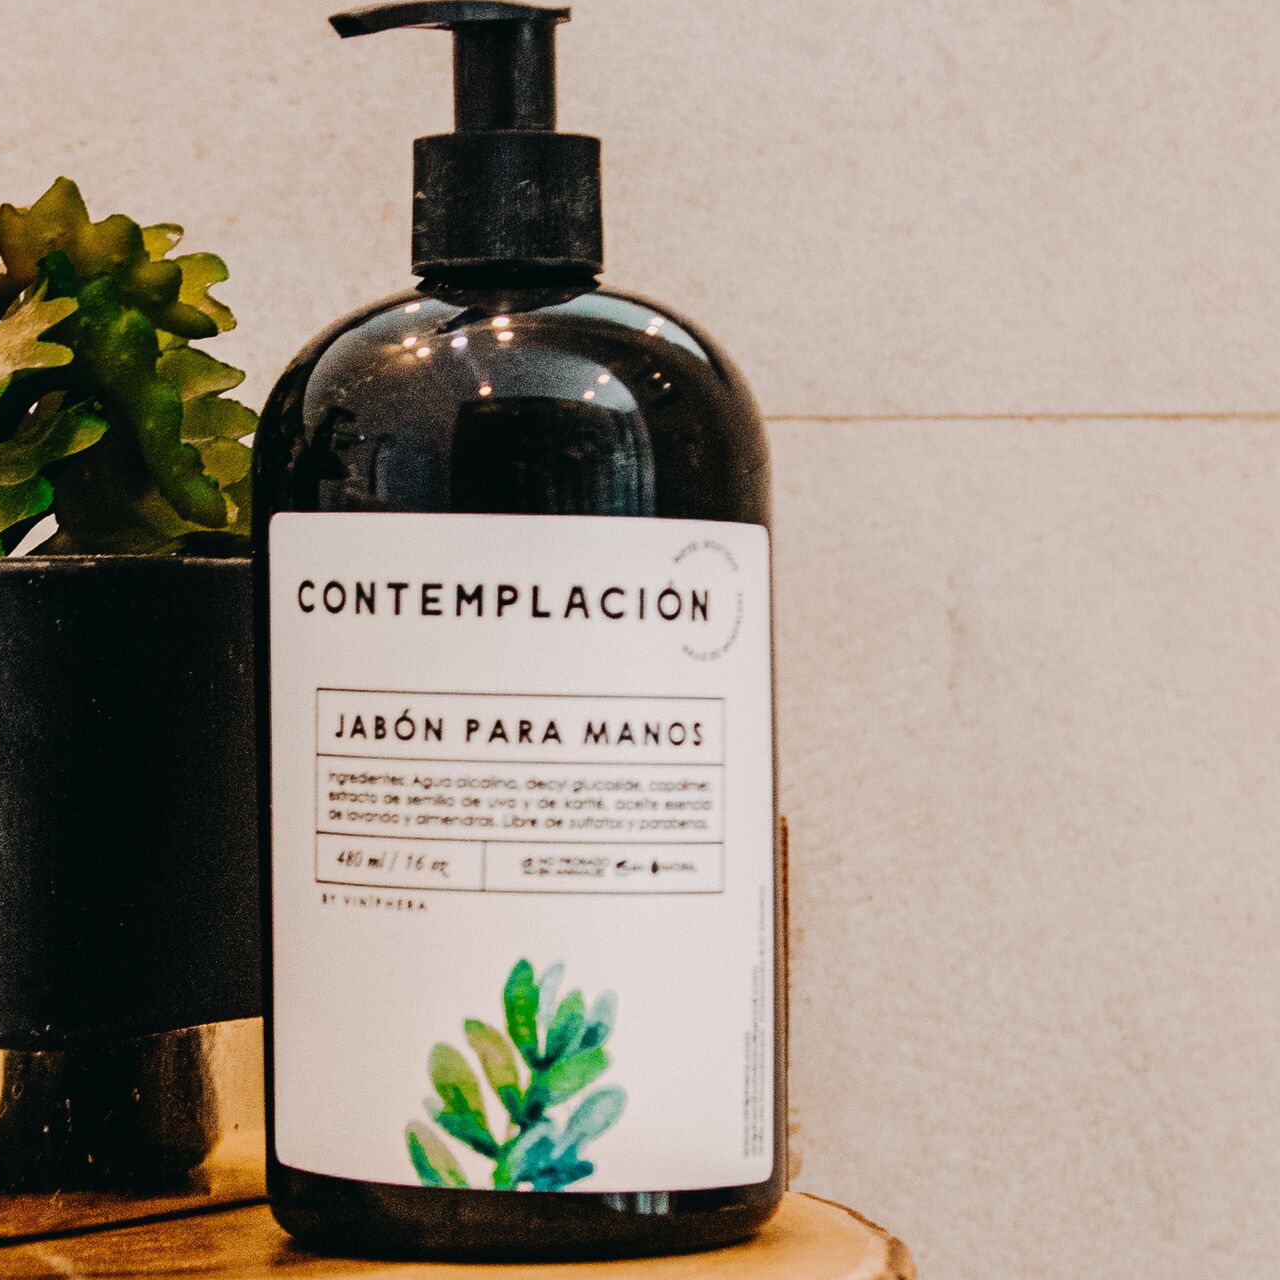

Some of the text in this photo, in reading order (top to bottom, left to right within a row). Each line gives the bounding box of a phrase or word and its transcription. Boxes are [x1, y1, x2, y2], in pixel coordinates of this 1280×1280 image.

[297, 578, 710, 622] CONTEMPLACIÓN
[334, 709, 706, 748] JABÓN PARA MANOS
[412, 775, 453, 790] Agua
[328, 790, 379, 805] extracto
[383, 792, 401, 806] de
[461, 795, 481, 808] de
[537, 796, 558, 810] de
[615, 797, 659, 811] aceite
[328, 808, 343, 821] de
[545, 816, 563, 829] de
[337, 850, 363, 868] 480
[368, 851, 389, 869] ml
[406, 853, 426, 871] 16
